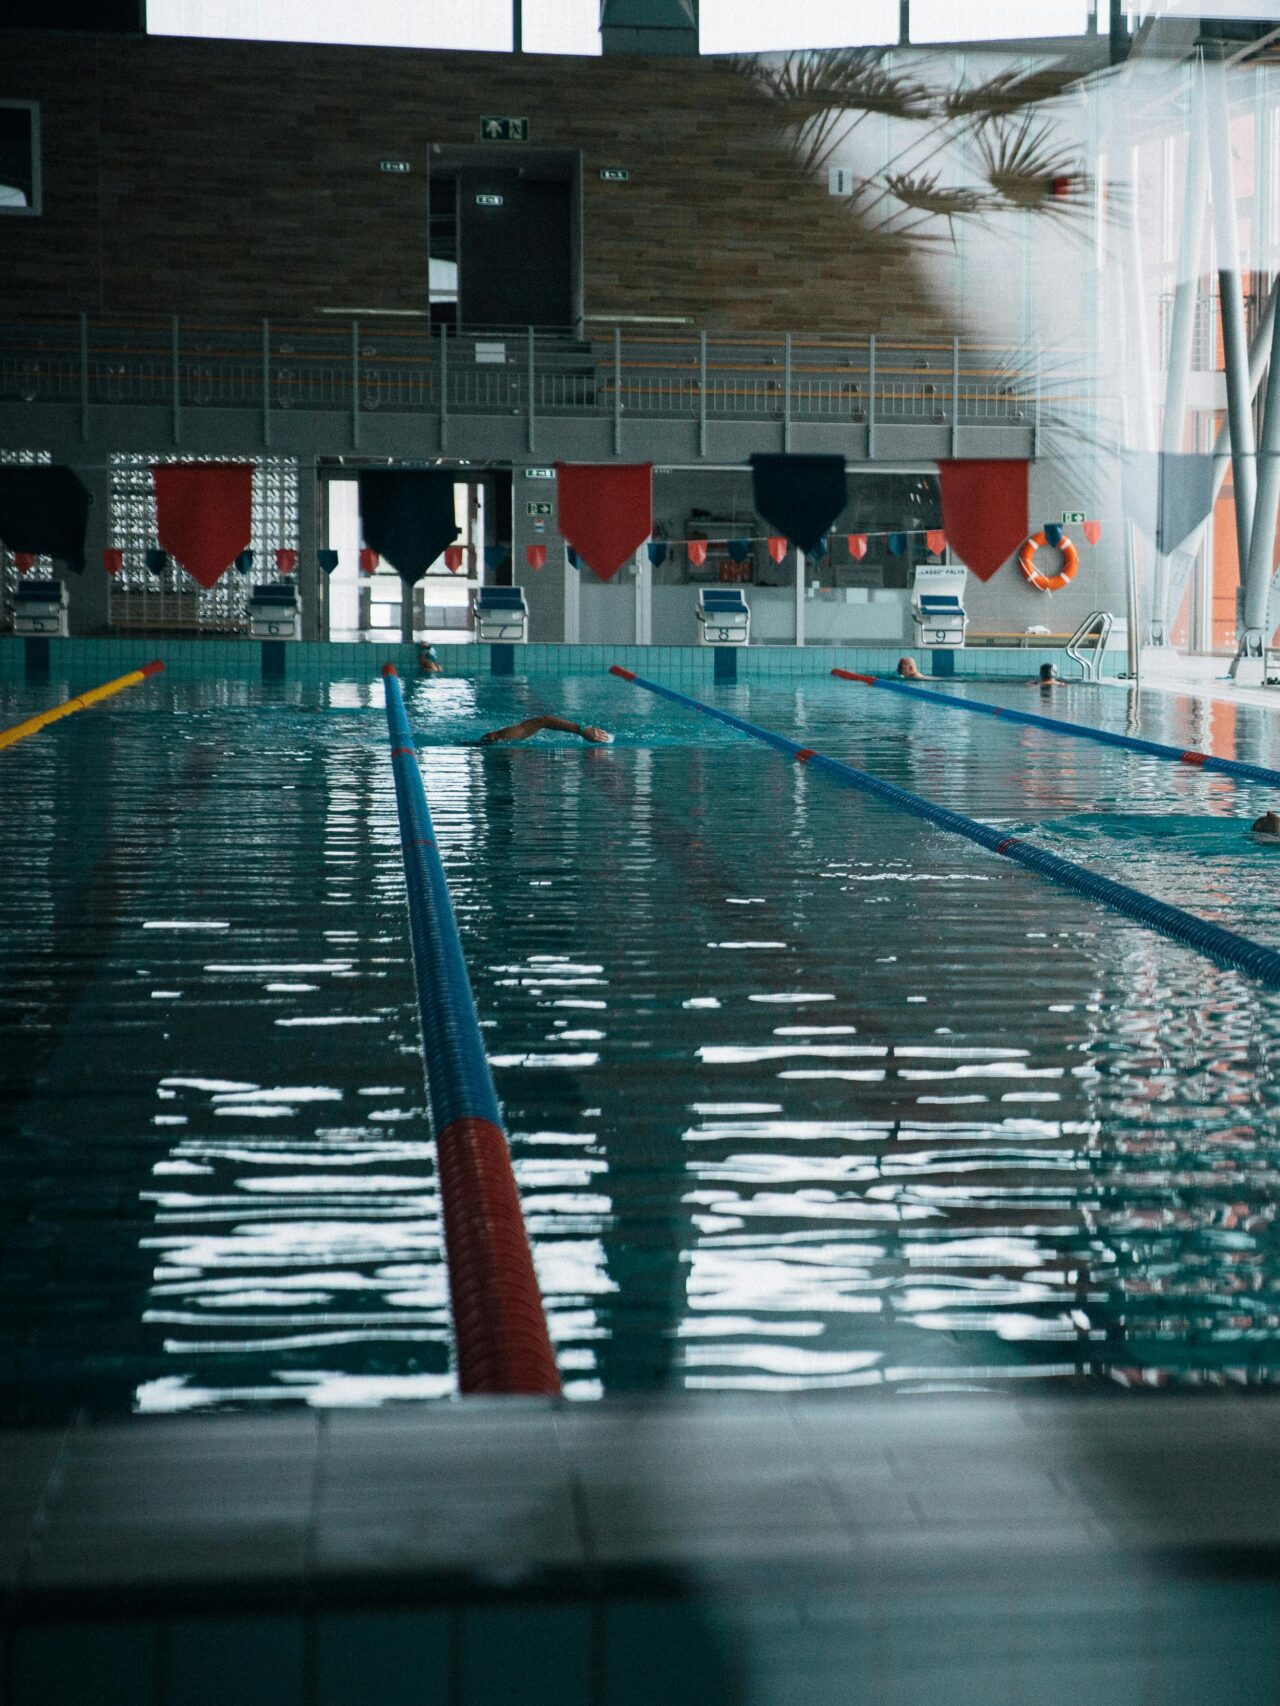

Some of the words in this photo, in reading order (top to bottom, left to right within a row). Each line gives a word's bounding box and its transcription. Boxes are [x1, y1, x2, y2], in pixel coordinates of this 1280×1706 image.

[32, 617, 44, 632] 5
[268, 621, 279, 636] 6
[719, 627, 729, 641] 8
[935, 630, 946, 644] 9
